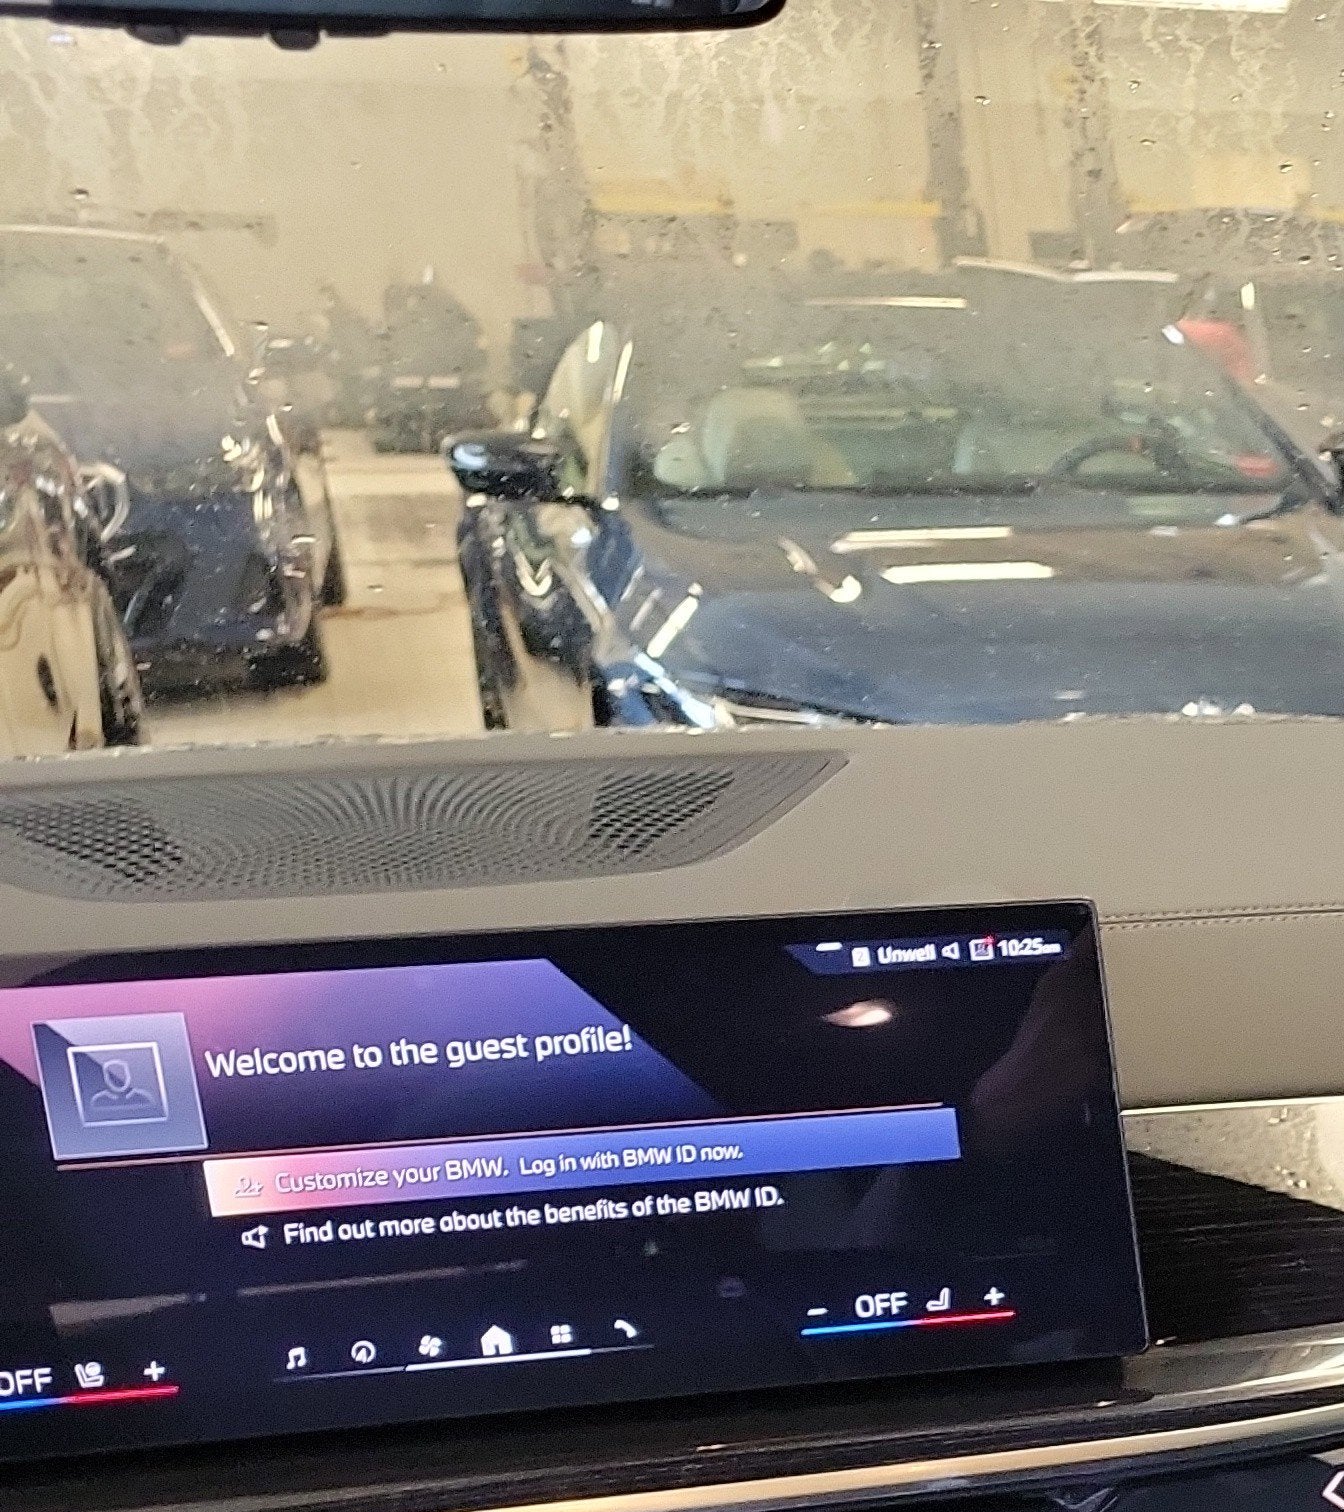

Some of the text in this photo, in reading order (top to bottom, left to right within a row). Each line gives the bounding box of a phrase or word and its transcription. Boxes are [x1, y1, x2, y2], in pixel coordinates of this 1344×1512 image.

[877, 943, 936, 964] Unwell
[204, 1023, 632, 1078] Welcome to the guest profile!
[274, 1144, 743, 1194] Customize your BMW. Log in with BMW ID now.
[283, 1185, 785, 1245] Find out more about the benefits of the BMW ID.
[855, 1291, 909, 1318] OFF
